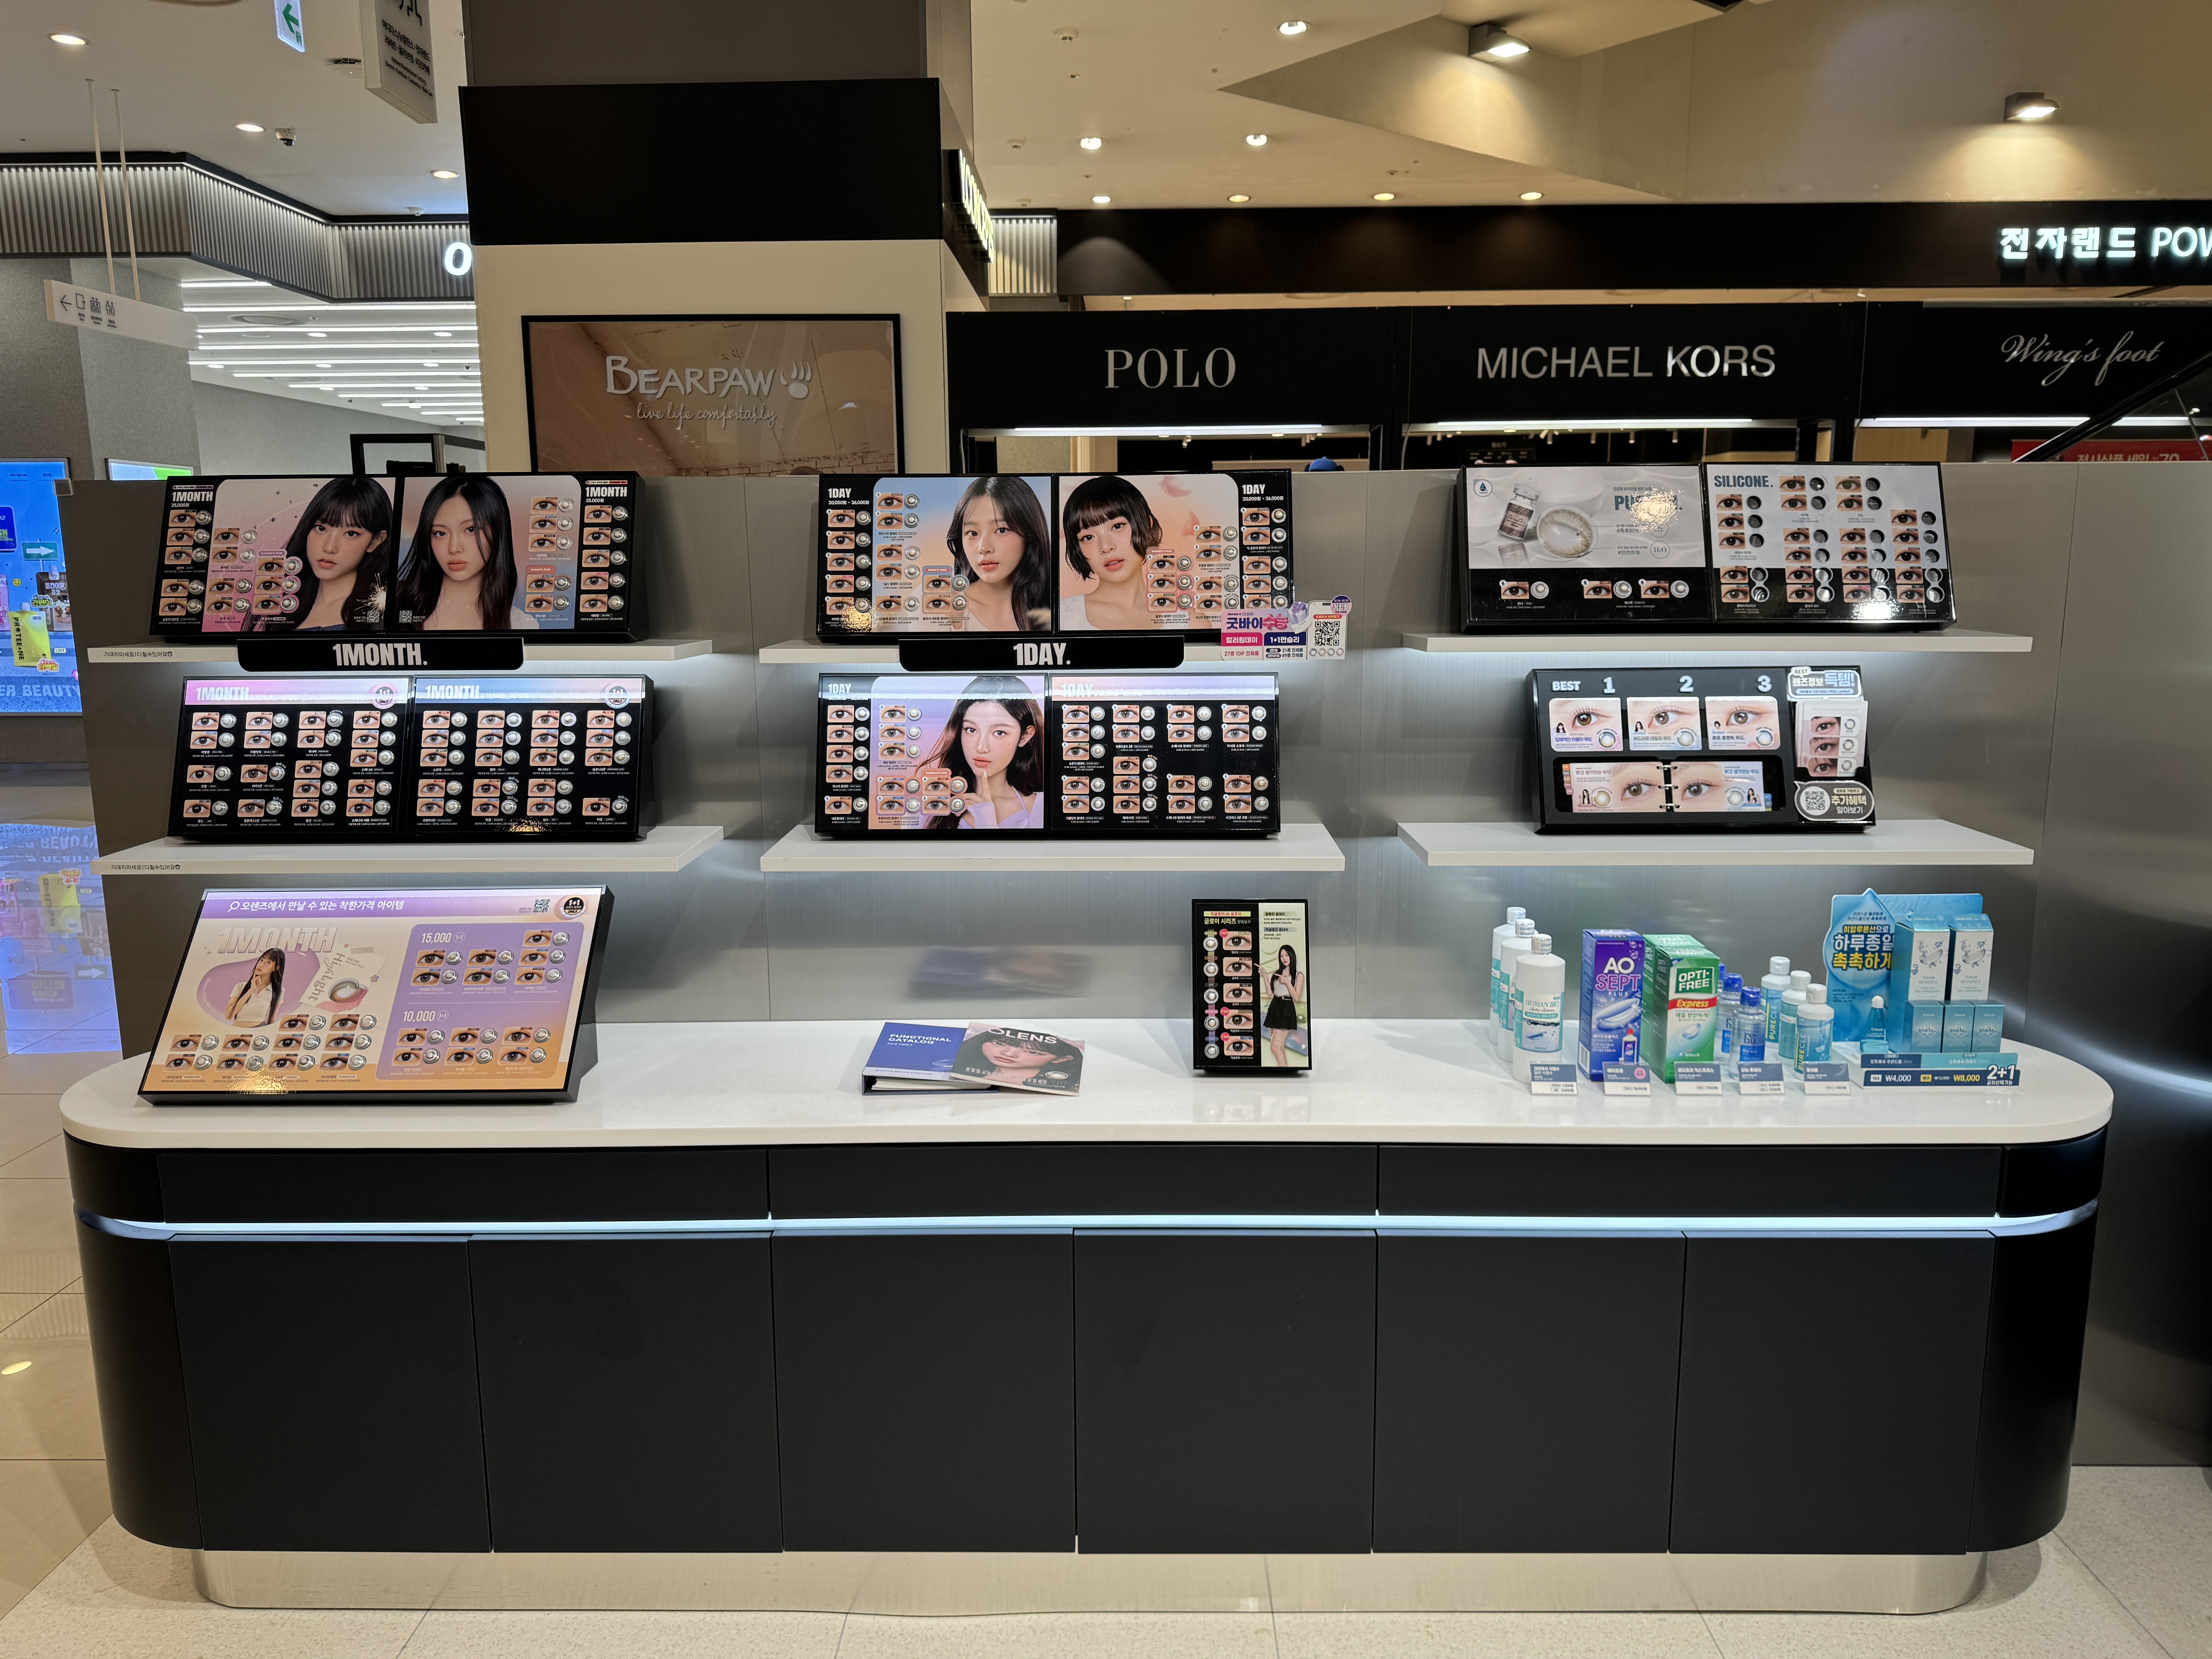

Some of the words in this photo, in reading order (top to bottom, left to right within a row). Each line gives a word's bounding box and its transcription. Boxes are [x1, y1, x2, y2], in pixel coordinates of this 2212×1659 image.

[2000, 226, 2136, 259] 전자랜드
[1477, 346, 1653, 379] MICHAEL
[1666, 344, 1776, 377] KORS
[2000, 333, 2101, 386] Wing's
[2094, 331, 2165, 386] foot
[1104, 347, 1236, 388] POLO
[606, 355, 776, 399] BEARPAW
[637, 402, 664, 421] live
[667, 402, 694, 429] life
[696, 403, 777, 429] comfortably
[1714, 475, 1774, 488] SILICONE.
[172, 491, 213, 502] 1MONTH
[586, 486, 627, 497] 1MONTH
[828, 488, 852, 498] 1DAY
[1242, 484, 1266, 495] 1DAY
[333, 643, 428, 666] 1MONTH.
[1013, 642, 1071, 666] 1DAY.
[1552, 681, 1581, 691] BEST
[1603, 677, 1616, 694] 1
[1680, 676, 1694, 692] 2
[1757, 675, 1772, 692] 3
[1825, 672, 1855, 687] 득템!
[828, 684, 852, 694] 1DAY
[1831, 795, 1867, 805] 추가혜택
[1836, 806, 1863, 814] 알아보기
[240, 901, 285, 911] 오렌즈에서
[288, 901, 306, 911] 만날
[307, 901, 317, 910] 수
[319, 900, 337, 911] 있는
[339, 900, 375, 910] 착한가격
[377, 900, 404, 910] 아이템
[217, 927, 338, 954] 1MONTH
[421, 933, 452, 944] 15,000
[1834, 933, 1895, 952] 하루종일
[1603, 957, 1635, 974] AO
[1595, 974, 1641, 992] SEPT
[1678, 969, 1710, 982] OPTI-
[1679, 978, 1709, 991] FREE
[1525, 1000, 1549, 1008] HUMAN
[1676, 999, 1709, 1009] Express
[403, 1011, 436, 1023] 10,000
[1769, 1005, 1777, 1040] PURECLE
[890, 1034, 951, 1042] FUNCTIONAL
[988, 1028, 1057, 1044] OLENS
[1987, 1064, 2014, 1080] 2+1
